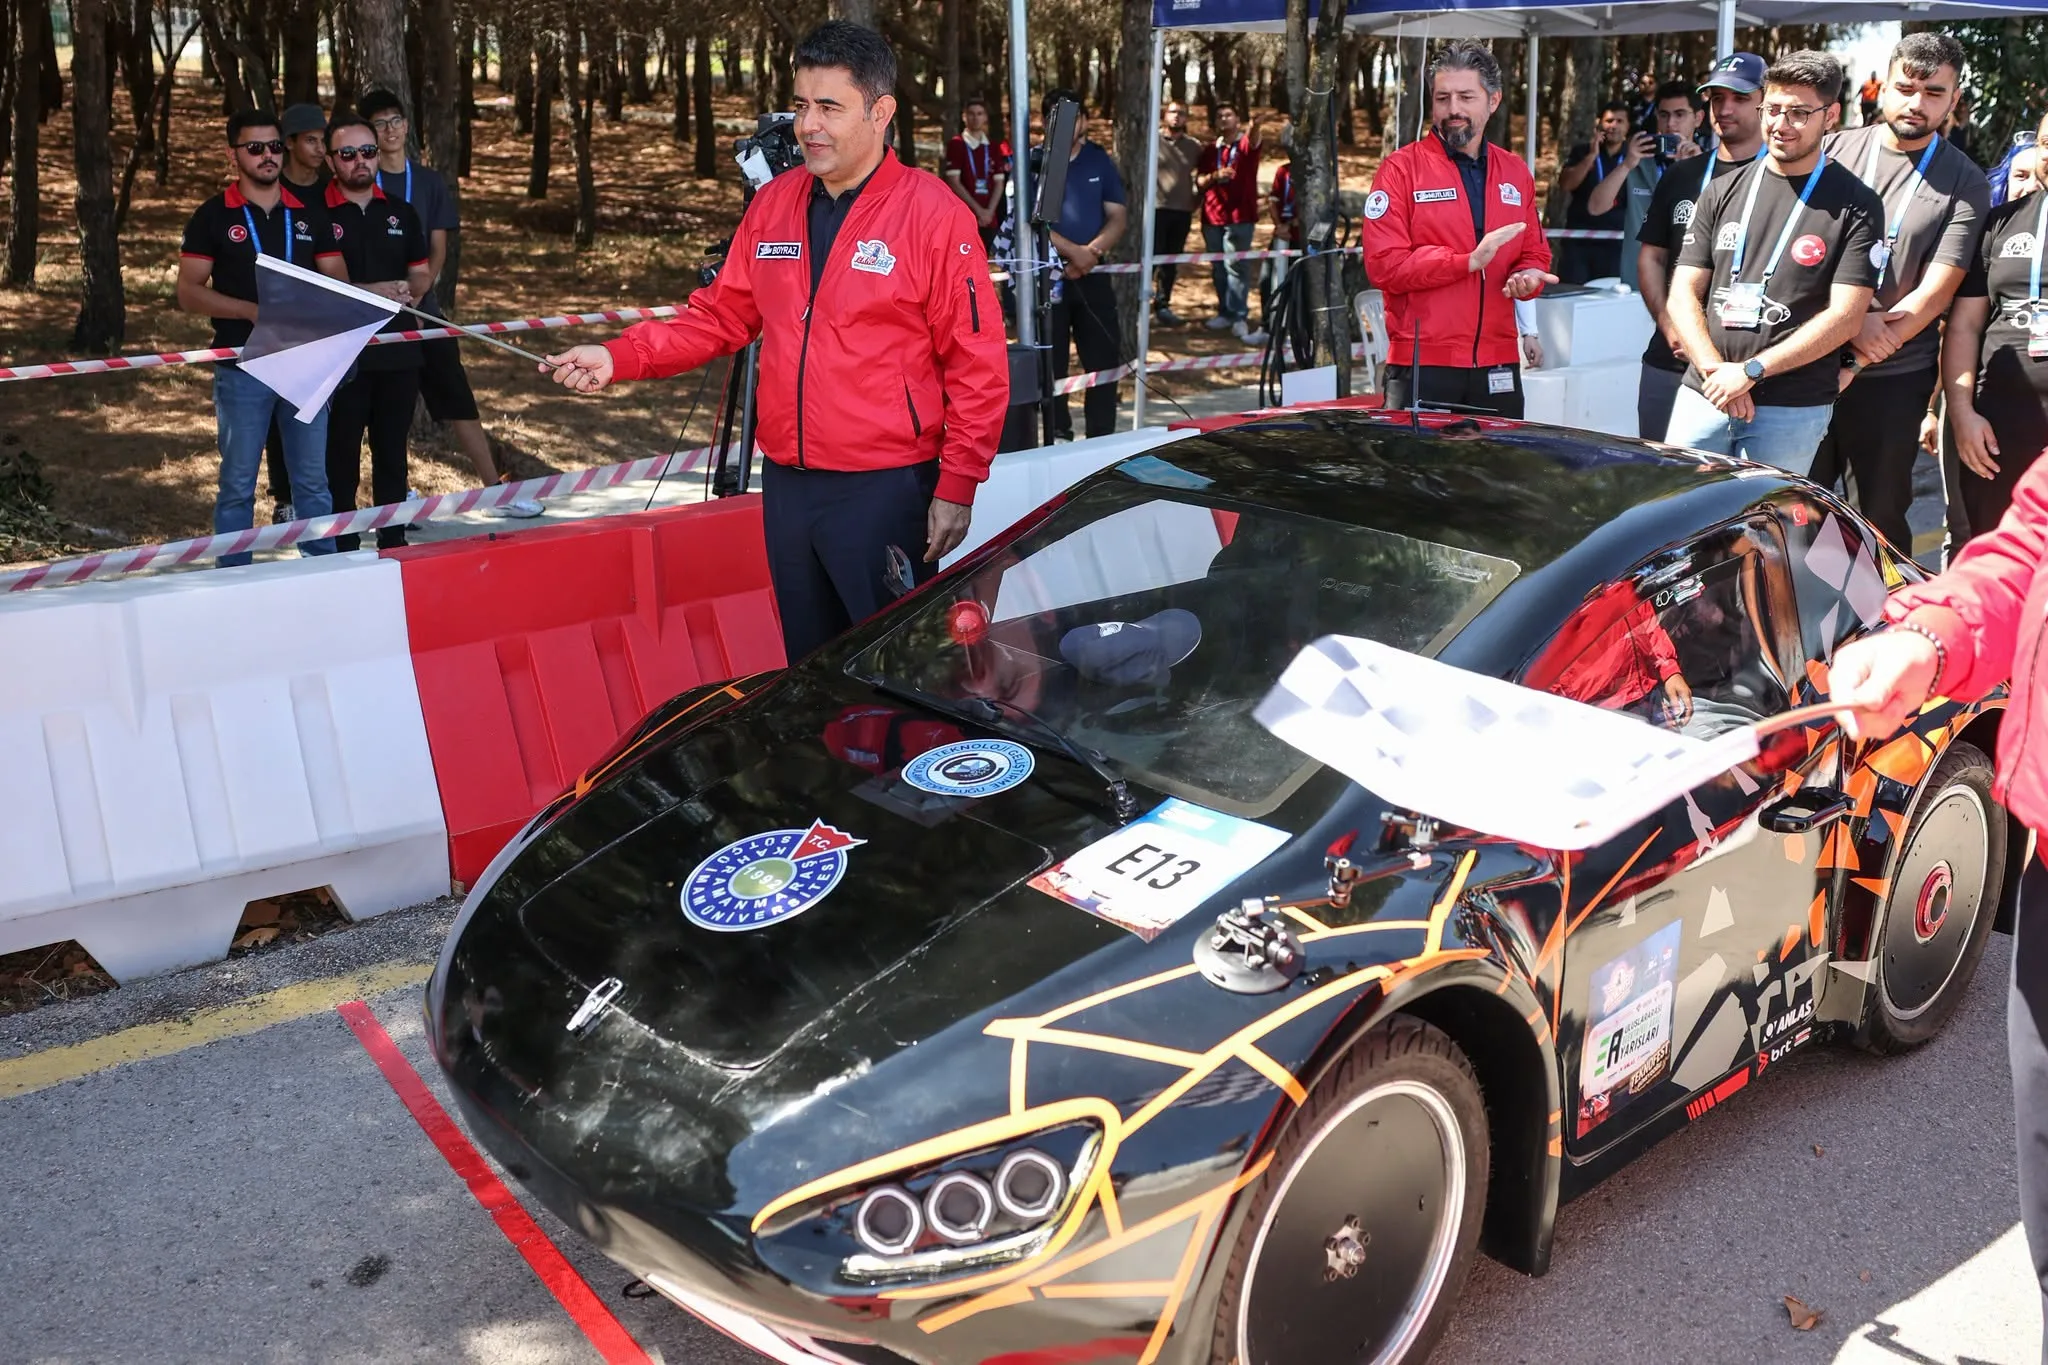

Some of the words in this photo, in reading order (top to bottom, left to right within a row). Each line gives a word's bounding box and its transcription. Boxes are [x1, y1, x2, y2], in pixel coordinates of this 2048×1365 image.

[772, 245, 797, 255] BOYRAZ
[934, 743, 1010, 758] TEKNOLOJİ
[808, 834, 832, 850] T.C.
[711, 846, 817, 911] KAHRAMANMARAŞ
[742, 865, 784, 890] 1992
[1105, 843, 1201, 889] E13
[1776, 998, 1813, 1035] ANLAS
[1771, 1040, 1791, 1062] brt
[1631, 1042, 1670, 1087] TEKNOFEST
